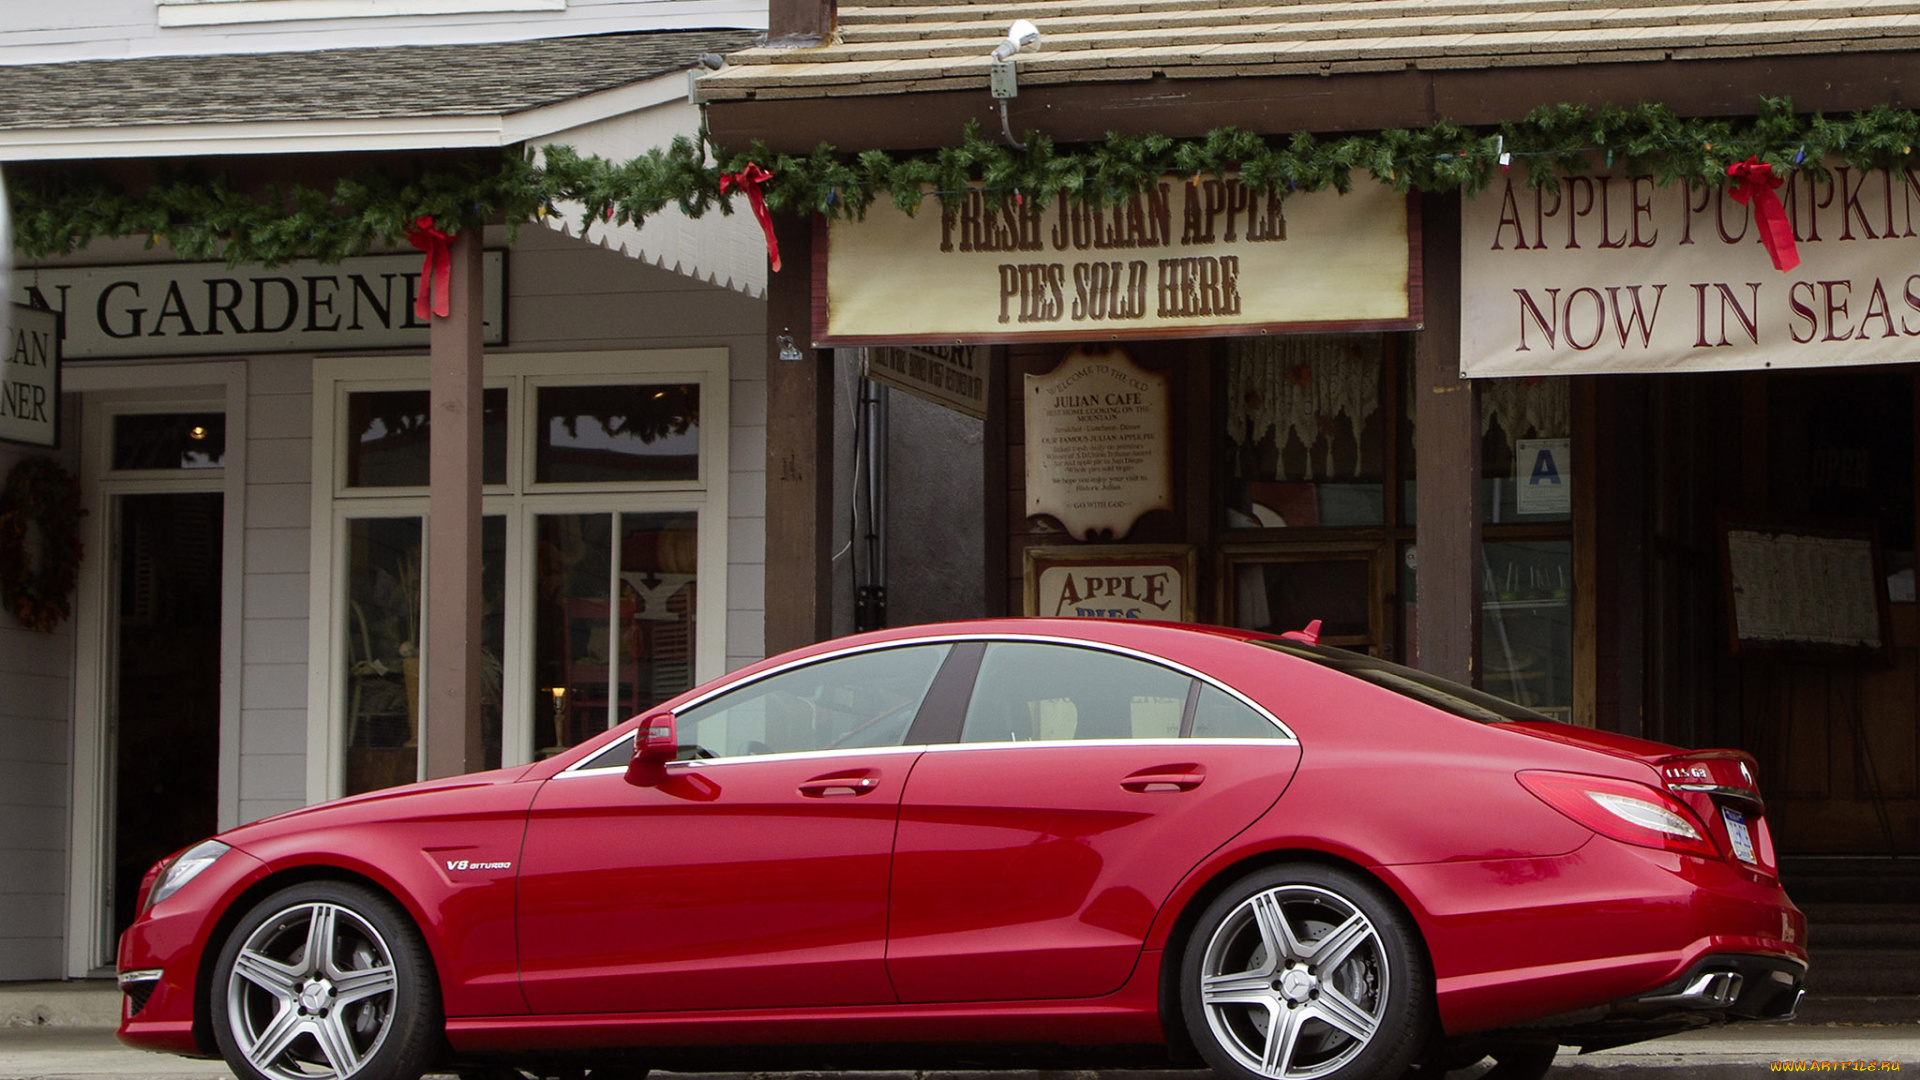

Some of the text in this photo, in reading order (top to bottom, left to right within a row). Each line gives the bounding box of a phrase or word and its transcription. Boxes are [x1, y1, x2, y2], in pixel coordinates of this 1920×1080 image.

[940, 178, 1287, 252] FRESH JULIAN APPLE
[1491, 174, 1658, 250] APPLE
[96, 272, 489, 339] GARDENE
[998, 256, 1241, 323] PIES SOLD HERE
[1512, 283, 1668, 351] NOW
[1689, 282, 1762, 348] IN
[1047, 365, 1149, 395] WELCOME TO THE OLD
[1054, 393, 1142, 408] JULIAN CAFE
[0, 381, 47, 423] NER
[1085, 407, 1120, 415] COOKING
[1529, 449, 1562, 485] A
[1055, 572, 1172, 617] APPLE
[446, 860, 511, 871] V8 BITURBO
